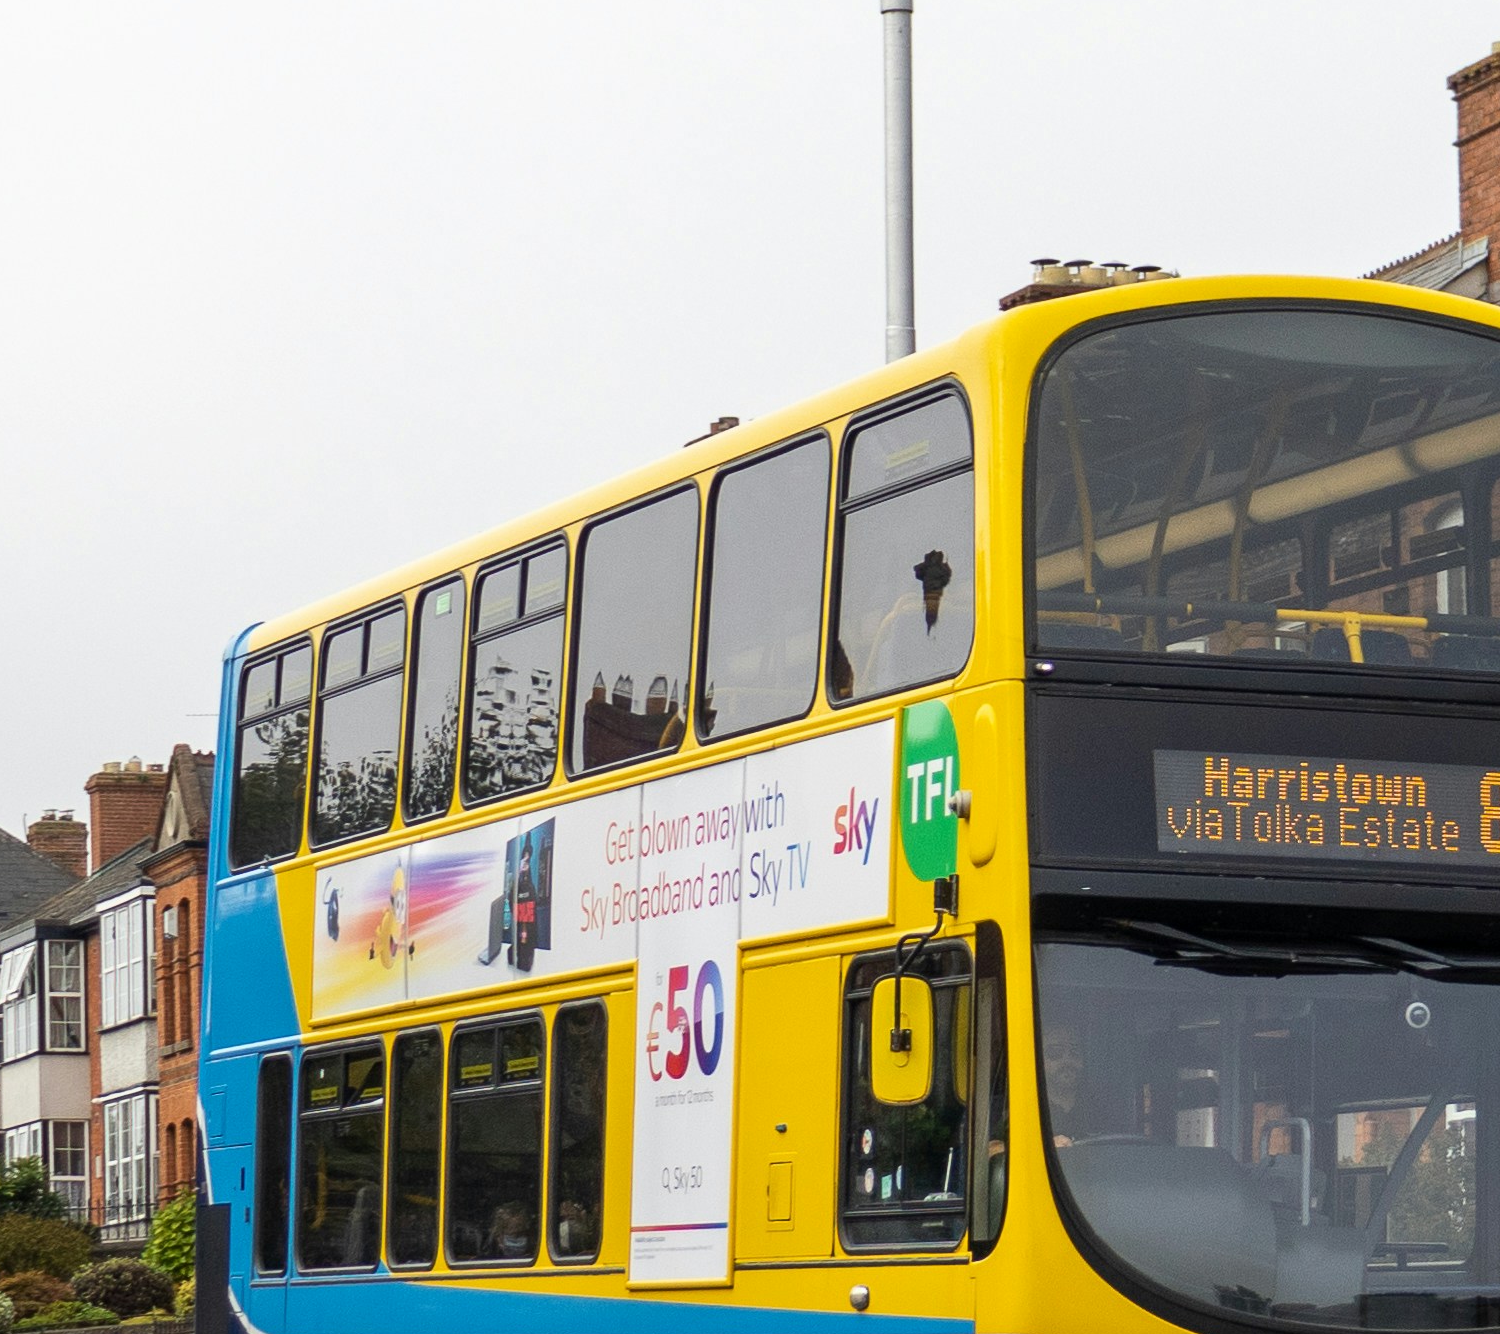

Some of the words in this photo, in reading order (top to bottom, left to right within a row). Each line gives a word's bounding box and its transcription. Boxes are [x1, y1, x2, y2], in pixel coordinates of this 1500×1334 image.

[605, 821, 635, 866] Get
[638, 810, 690, 858] blown
[695, 804, 740, 850] away
[744, 780, 785, 834] with
[1204, 757, 1426, 807] Harristown
[833, 786, 879, 866] sky
[1339, 807, 1459, 851] Estate
[580, 886, 610, 940] Sky
[612, 862, 705, 926] Broadband
[749, 849, 783, 907] Sky
[786, 841, 811, 891] TV
[646, 959, 725, 1082] €50
